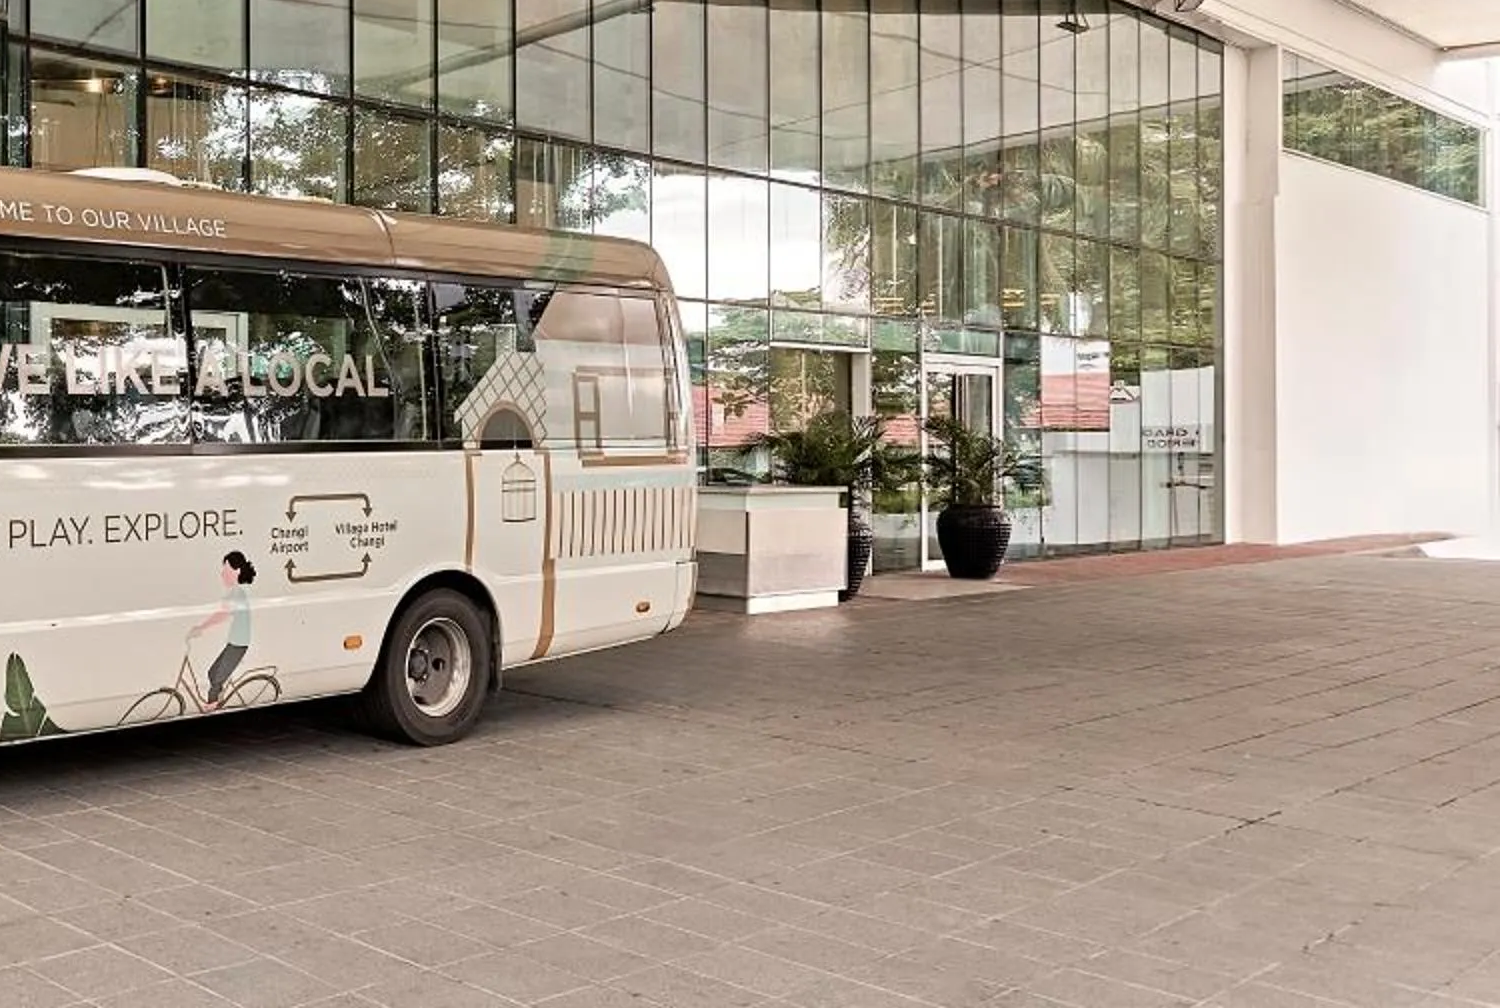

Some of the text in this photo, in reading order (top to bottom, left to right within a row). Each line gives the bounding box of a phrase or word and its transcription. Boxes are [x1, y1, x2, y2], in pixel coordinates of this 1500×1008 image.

[43, 204, 73, 226] TO
[81, 208, 132, 231] OUR
[138, 213, 227, 239] VILLAGE
[66, 342, 180, 396] LIKE
[195, 348, 230, 396] A
[243, 352, 389, 398] LOCAL
[8, 516, 93, 550] PLAY.
[104, 508, 244, 544] EXPLORE.
[271, 526, 309, 539] Changi
[335, 520, 398, 536] Village Hotel
[270, 541, 309, 555] Airport
[349, 535, 385, 548] Changi
